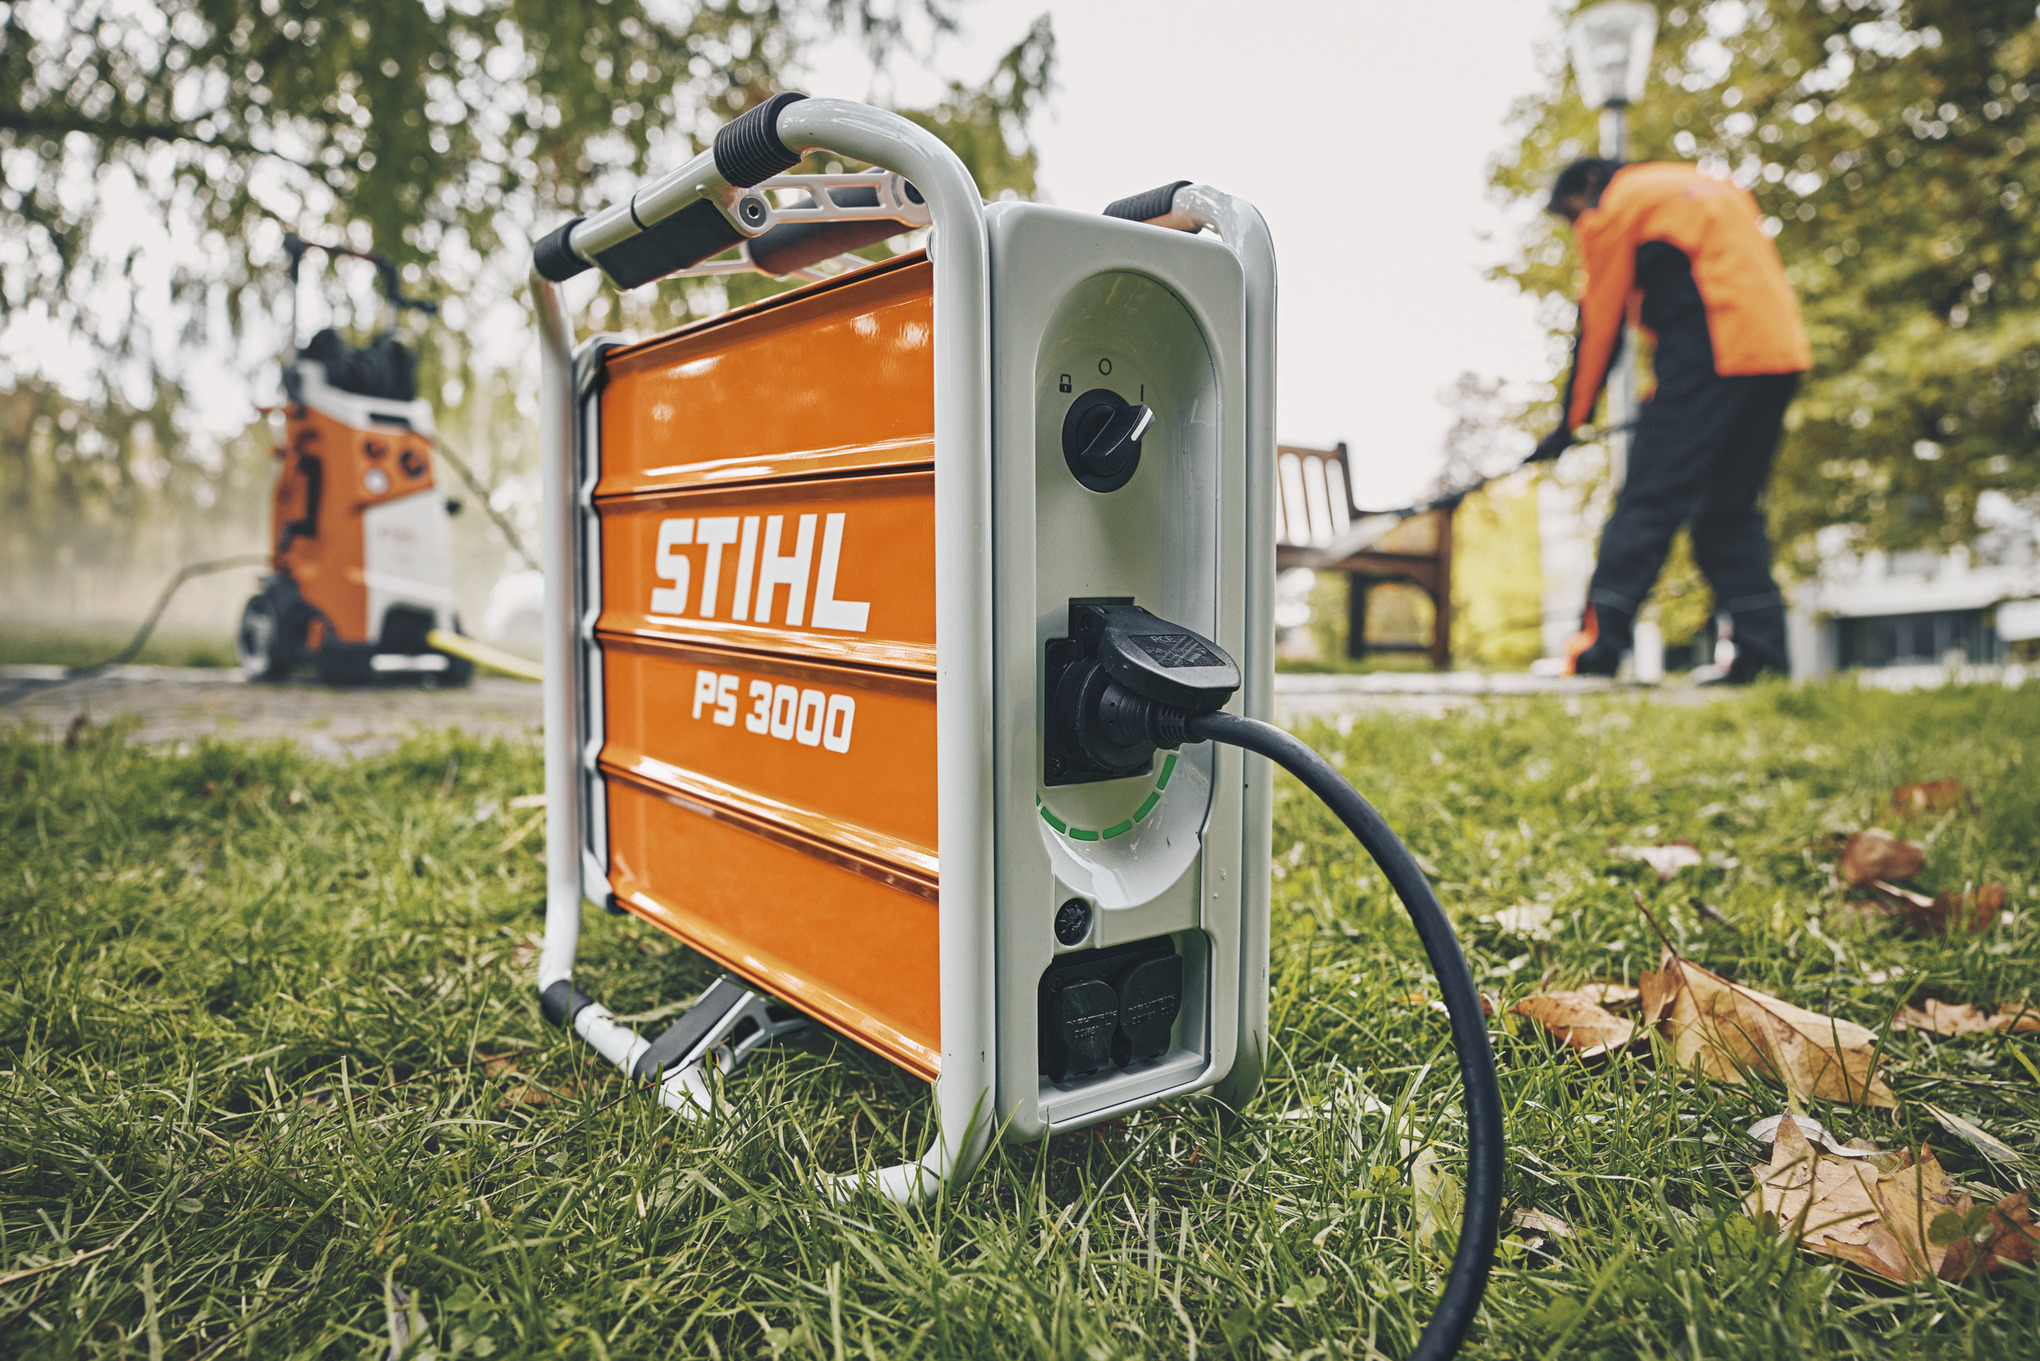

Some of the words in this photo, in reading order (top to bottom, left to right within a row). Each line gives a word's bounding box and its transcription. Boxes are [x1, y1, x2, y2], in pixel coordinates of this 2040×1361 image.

[651, 513, 871, 632] STIHL
[692, 670, 740, 727] PS
[745, 680, 856, 754] 3000
